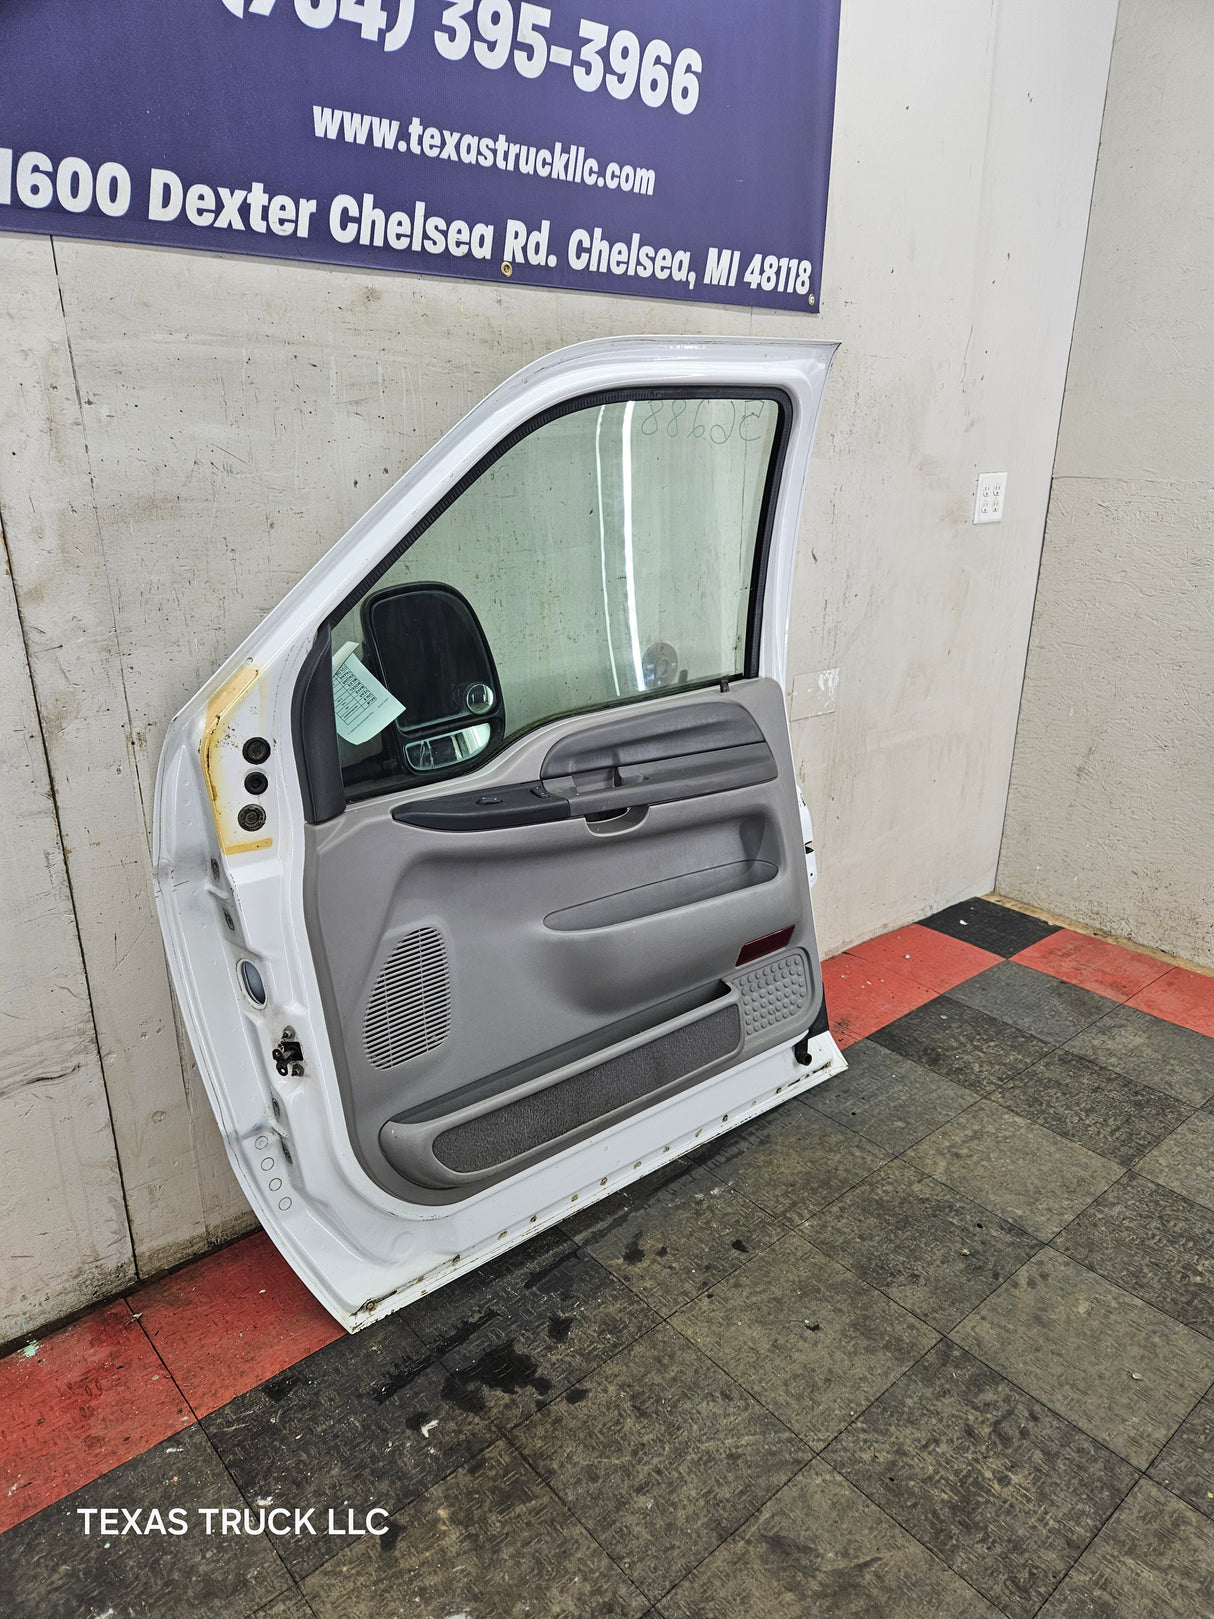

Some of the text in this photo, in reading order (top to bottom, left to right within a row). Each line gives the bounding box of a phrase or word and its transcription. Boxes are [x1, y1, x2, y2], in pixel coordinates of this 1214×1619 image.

[434, 0, 703, 115] 395-3966
[312, 105, 656, 196] www.texastruckllc.com
[148, 167, 317, 239] Dexter
[329, 193, 495, 261] Chelsea
[503, 218, 558, 268] Rd.
[567, 227, 697, 290] Chelsea,
[703, 247, 741, 287] MI
[743, 253, 812, 295] 48118
